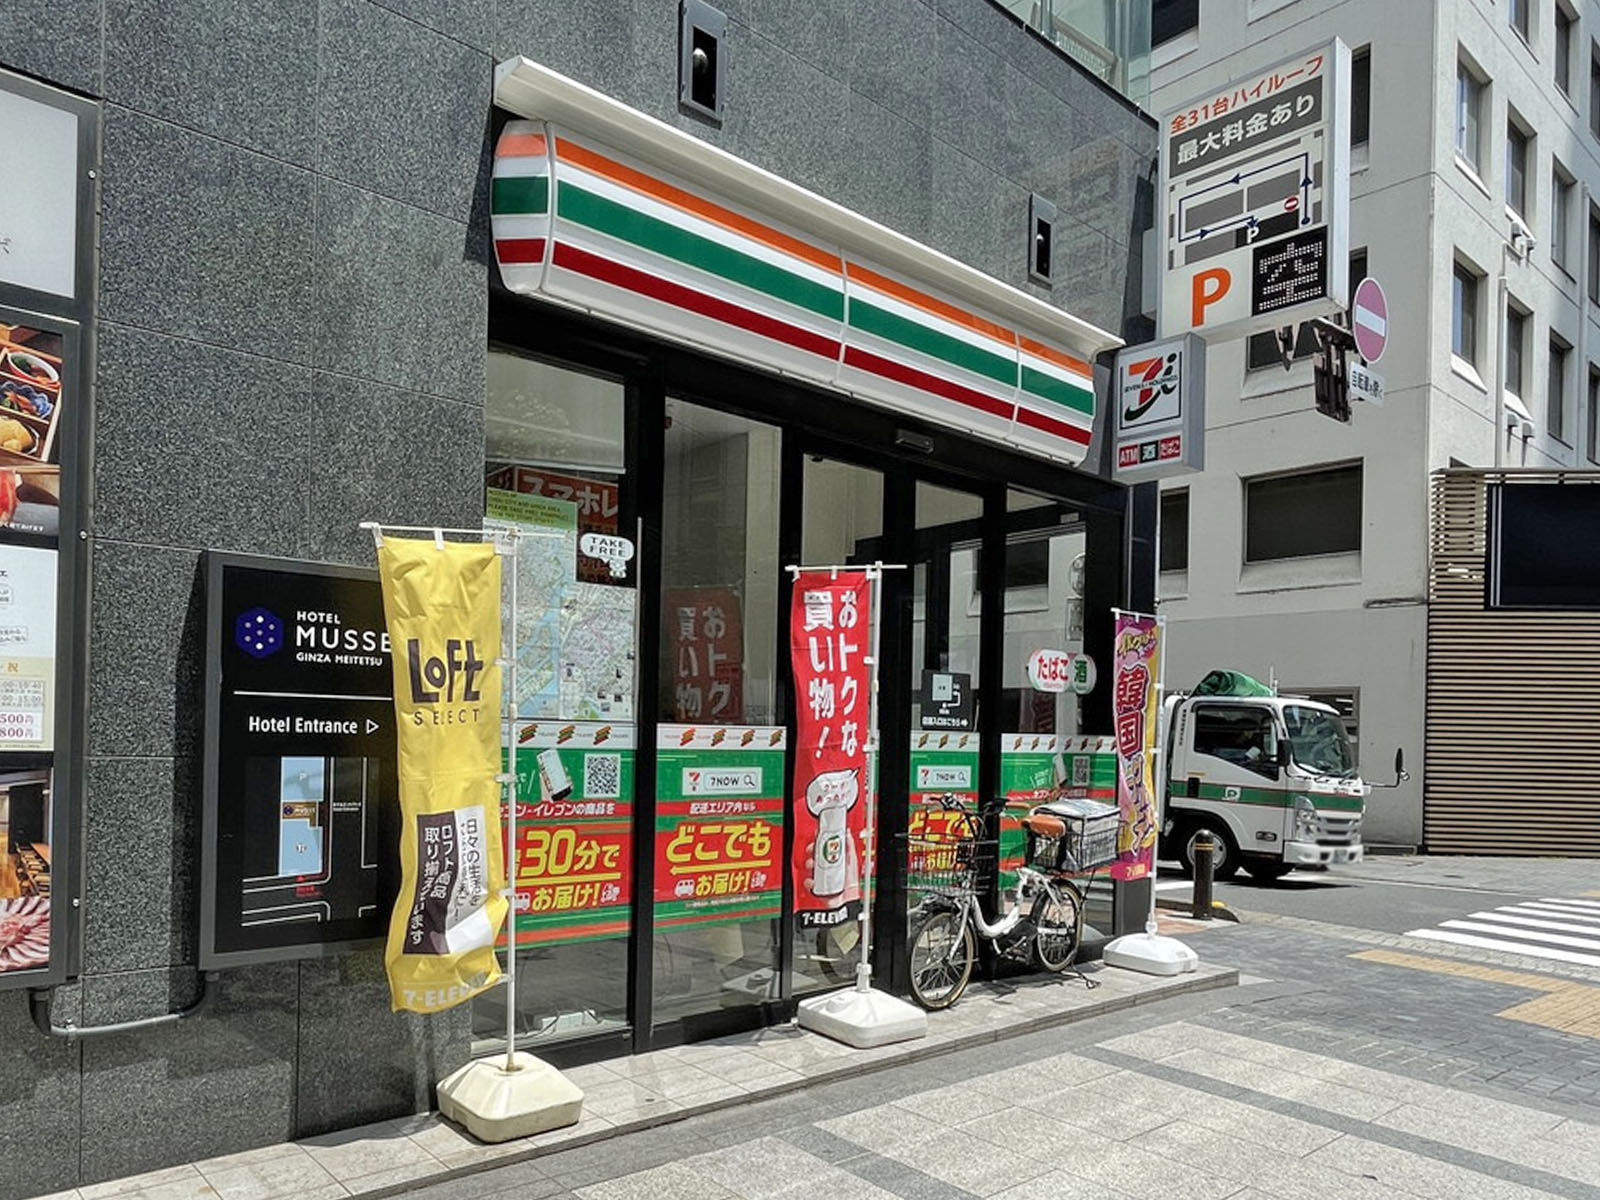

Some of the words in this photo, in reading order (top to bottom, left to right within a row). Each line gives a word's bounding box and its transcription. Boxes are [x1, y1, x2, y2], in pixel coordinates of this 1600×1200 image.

[1171, 56, 1323, 134] 全31台ハイルーフ
[1177, 94, 1314, 165] 最大料金あり
[1247, 226, 1259, 244] P
[1192, 267, 1231, 327] P
[589, 546, 627, 557] FREE
[591, 537, 626, 548] TAKE
[297, 611, 341, 625] HOTEL
[296, 652, 332, 664] GINZA
[335, 655, 383, 666] MEITETSU
[1037, 656, 1069, 682] たばこ
[803, 590, 834, 759] 買い物！
[839, 590, 859, 757] おトクな
[1073, 660, 1088, 684] 酒
[249, 716, 290, 733] Hotel
[295, 718, 358, 734] Entrance
[413, 708, 480, 726] SEECT
[710, 775, 740, 787] 7NOW
[666, 821, 771, 863] どこでも
[696, 871, 750, 897] お届け!
